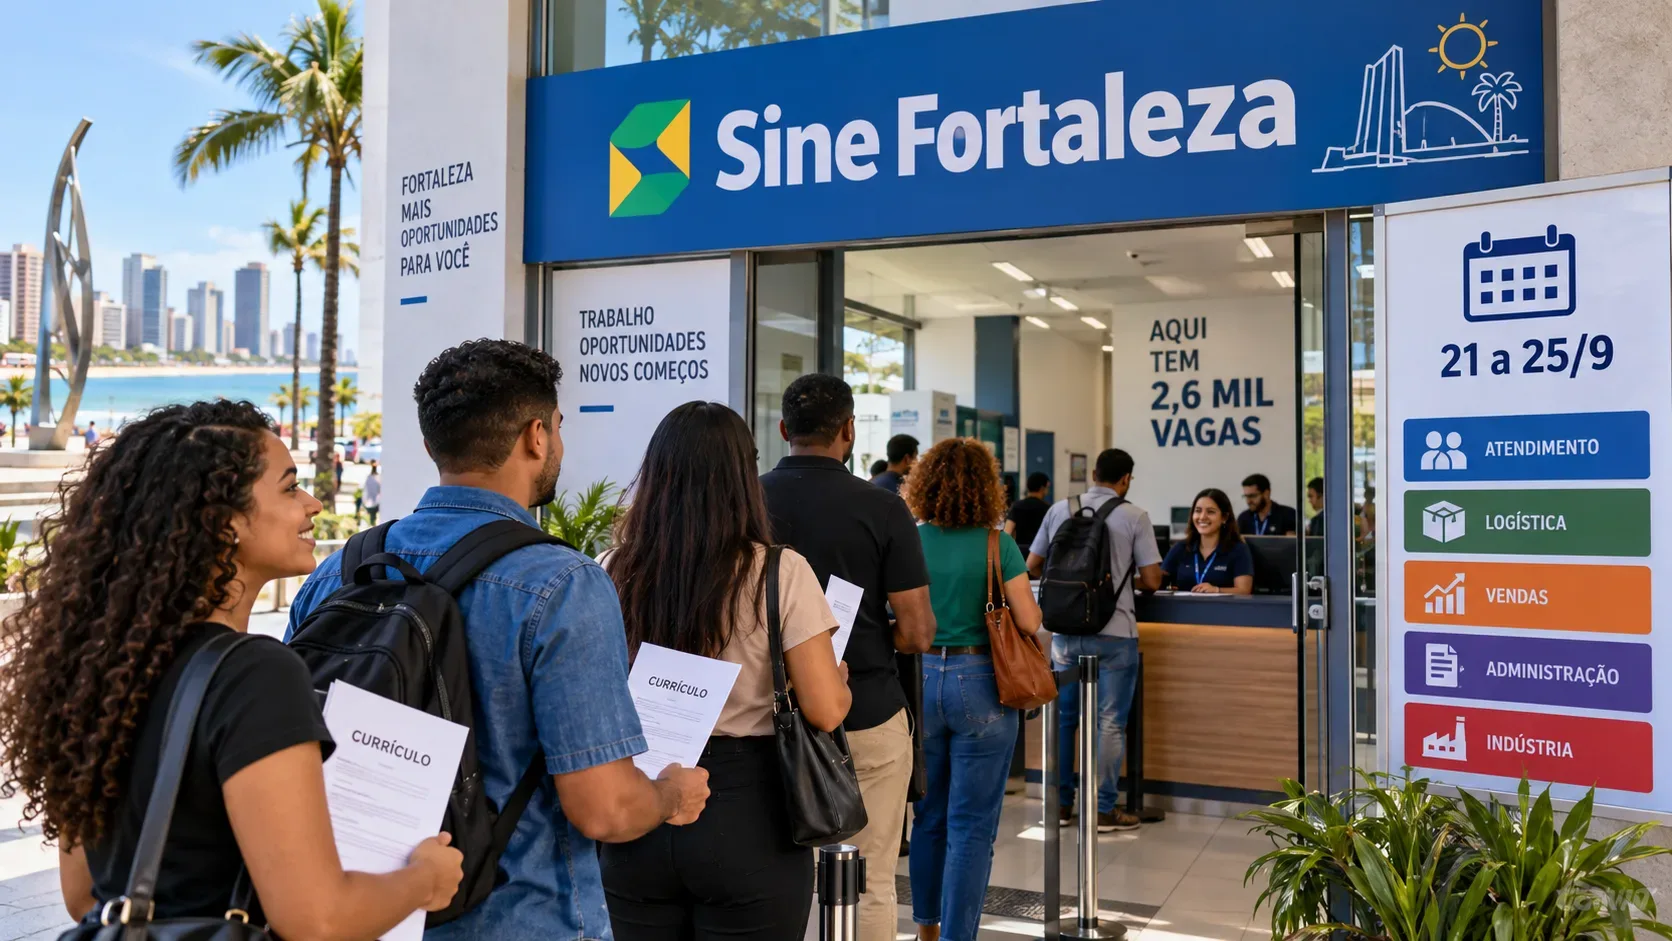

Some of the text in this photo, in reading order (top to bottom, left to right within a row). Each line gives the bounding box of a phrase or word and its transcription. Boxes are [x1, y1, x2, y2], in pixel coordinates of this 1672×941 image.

[715, 70, 1297, 191] Sine Fortaleza
[401, 161, 474, 196] FORTALEZA
[401, 198, 432, 223] MAIS
[400, 211, 499, 248] OPORTUNIDADES
[400, 241, 470, 277] PARA VOCÊ
[578, 305, 655, 330] TRABALHO
[1149, 316, 1207, 345] AQUI
[579, 330, 706, 356] OPORTUNIDADES
[1440, 333, 1614, 379] 21 a 25/9
[579, 359, 709, 385] NOVOS COMEÇOS
[1149, 348, 1200, 373] TEM
[1151, 377, 1274, 416] 2,6 MIL
[1150, 415, 1262, 448] VAGAS
[1484, 438, 1600, 457] ATENDIMENTO
[1485, 510, 1567, 531] LOGÍSTICA
[1485, 587, 1549, 605] VENDAS
[648, 675, 708, 699] CURRÍCULO
[1485, 660, 1620, 688] ADMINISTRAÇÃO
[351, 729, 431, 767] CURRÍCULO
[1487, 733, 1574, 759] INDÚSTRIA
